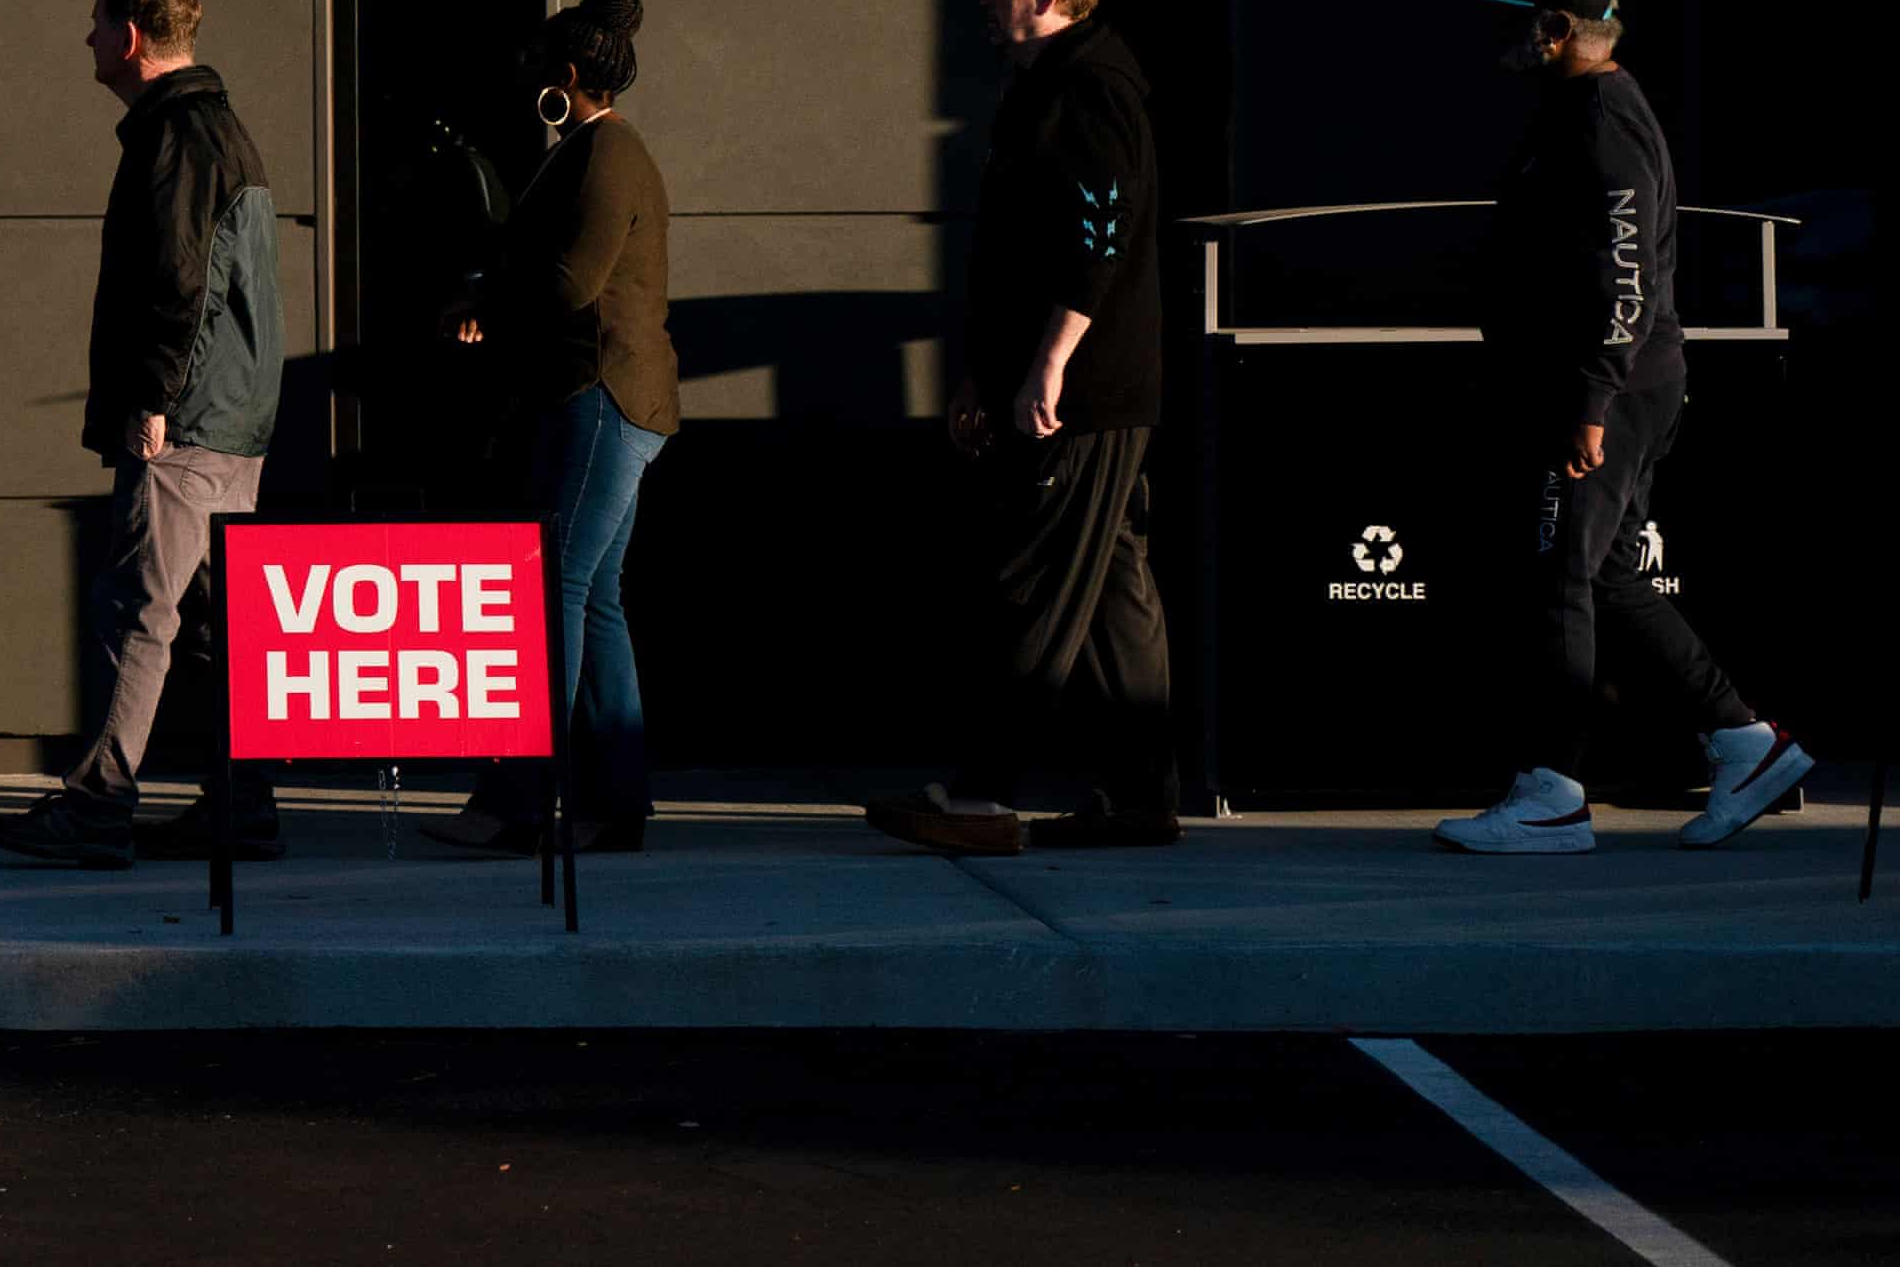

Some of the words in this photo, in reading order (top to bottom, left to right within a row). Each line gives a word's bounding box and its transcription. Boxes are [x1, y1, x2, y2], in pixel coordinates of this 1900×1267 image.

[1603, 189, 1644, 347] NAUTICA
[1539, 469, 1561, 554] AUTICA
[263, 564, 515, 633] VOTE
[1328, 582, 1427, 600] RECYCLE
[266, 650, 521, 720] HERE
